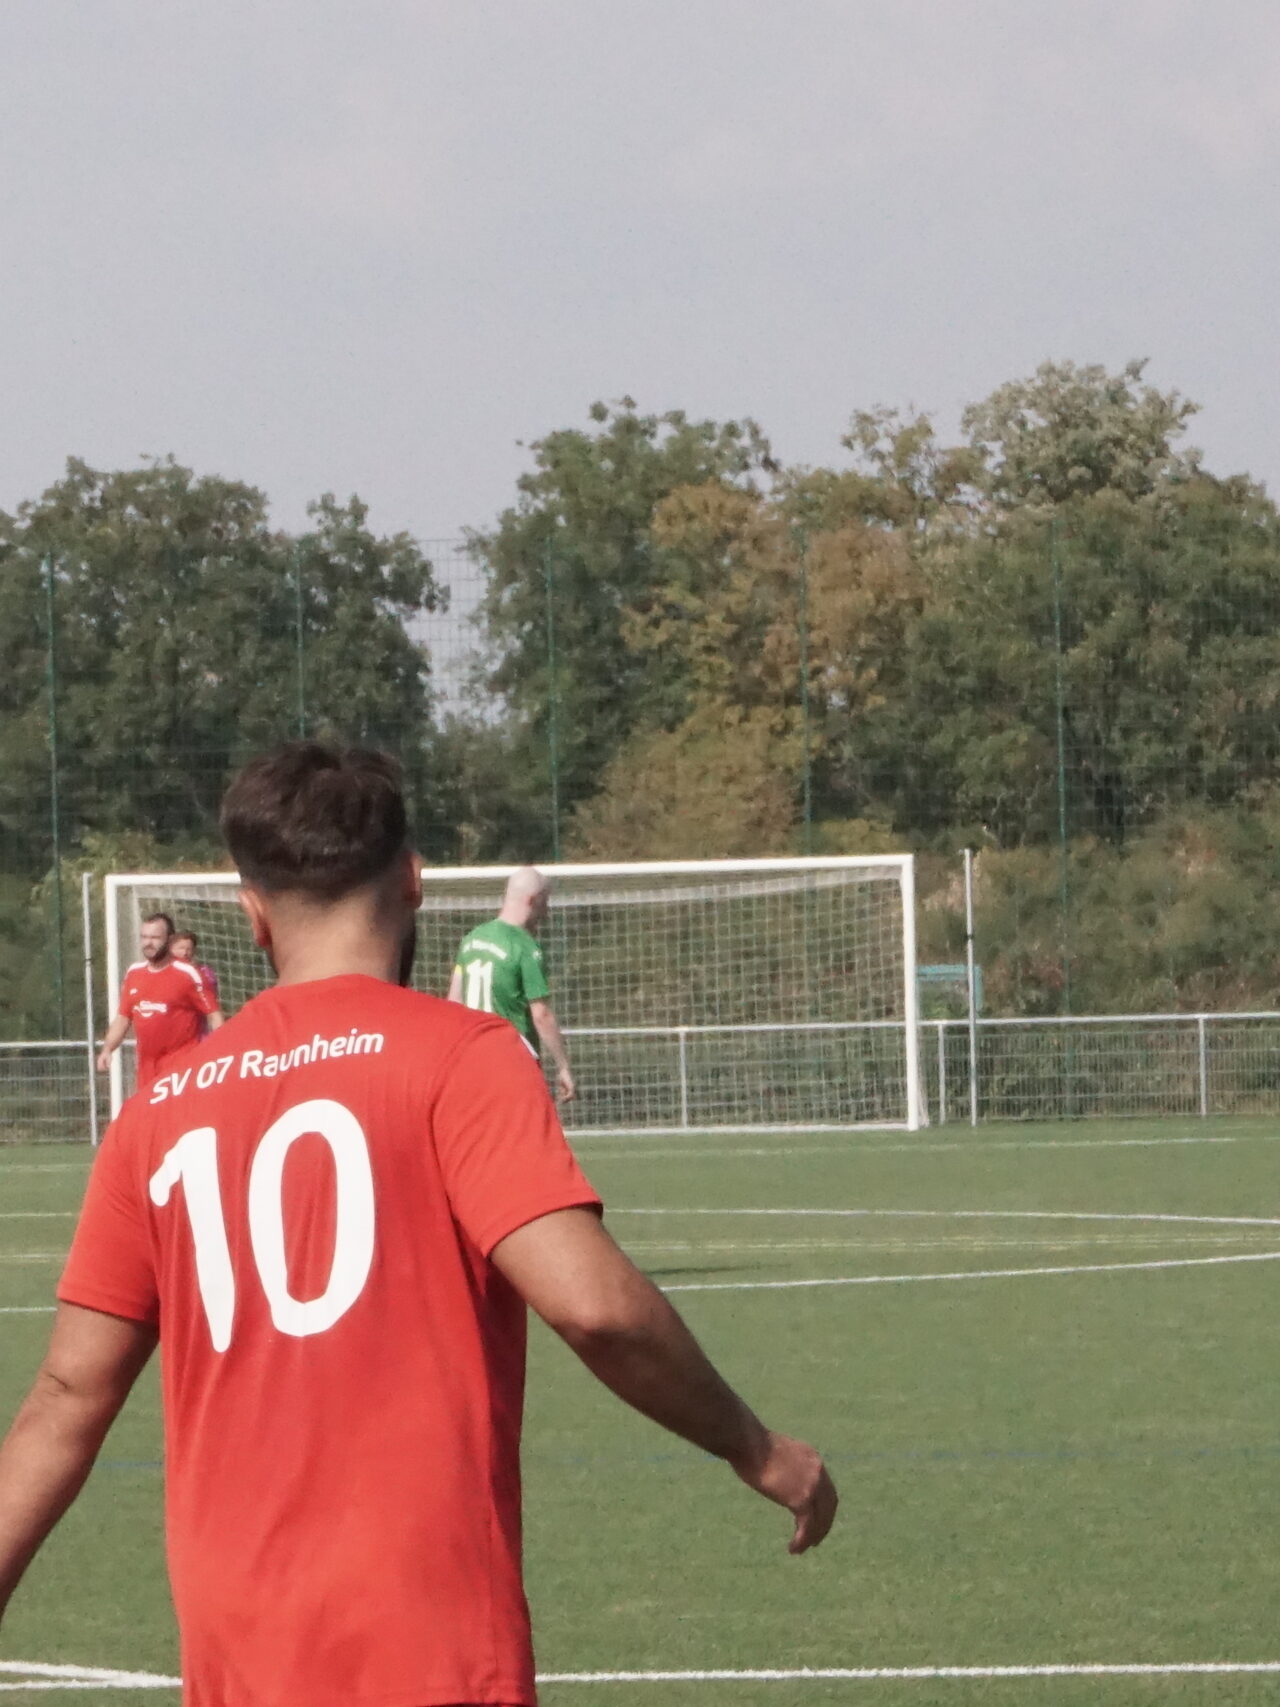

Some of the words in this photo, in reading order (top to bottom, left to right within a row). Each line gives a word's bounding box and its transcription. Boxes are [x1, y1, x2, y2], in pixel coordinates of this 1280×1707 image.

[466, 959, 493, 1013] 11
[197, 1056, 234, 1089] 07
[240, 1029, 384, 1079] Raunheim
[150, 1099, 375, 1353] 10
